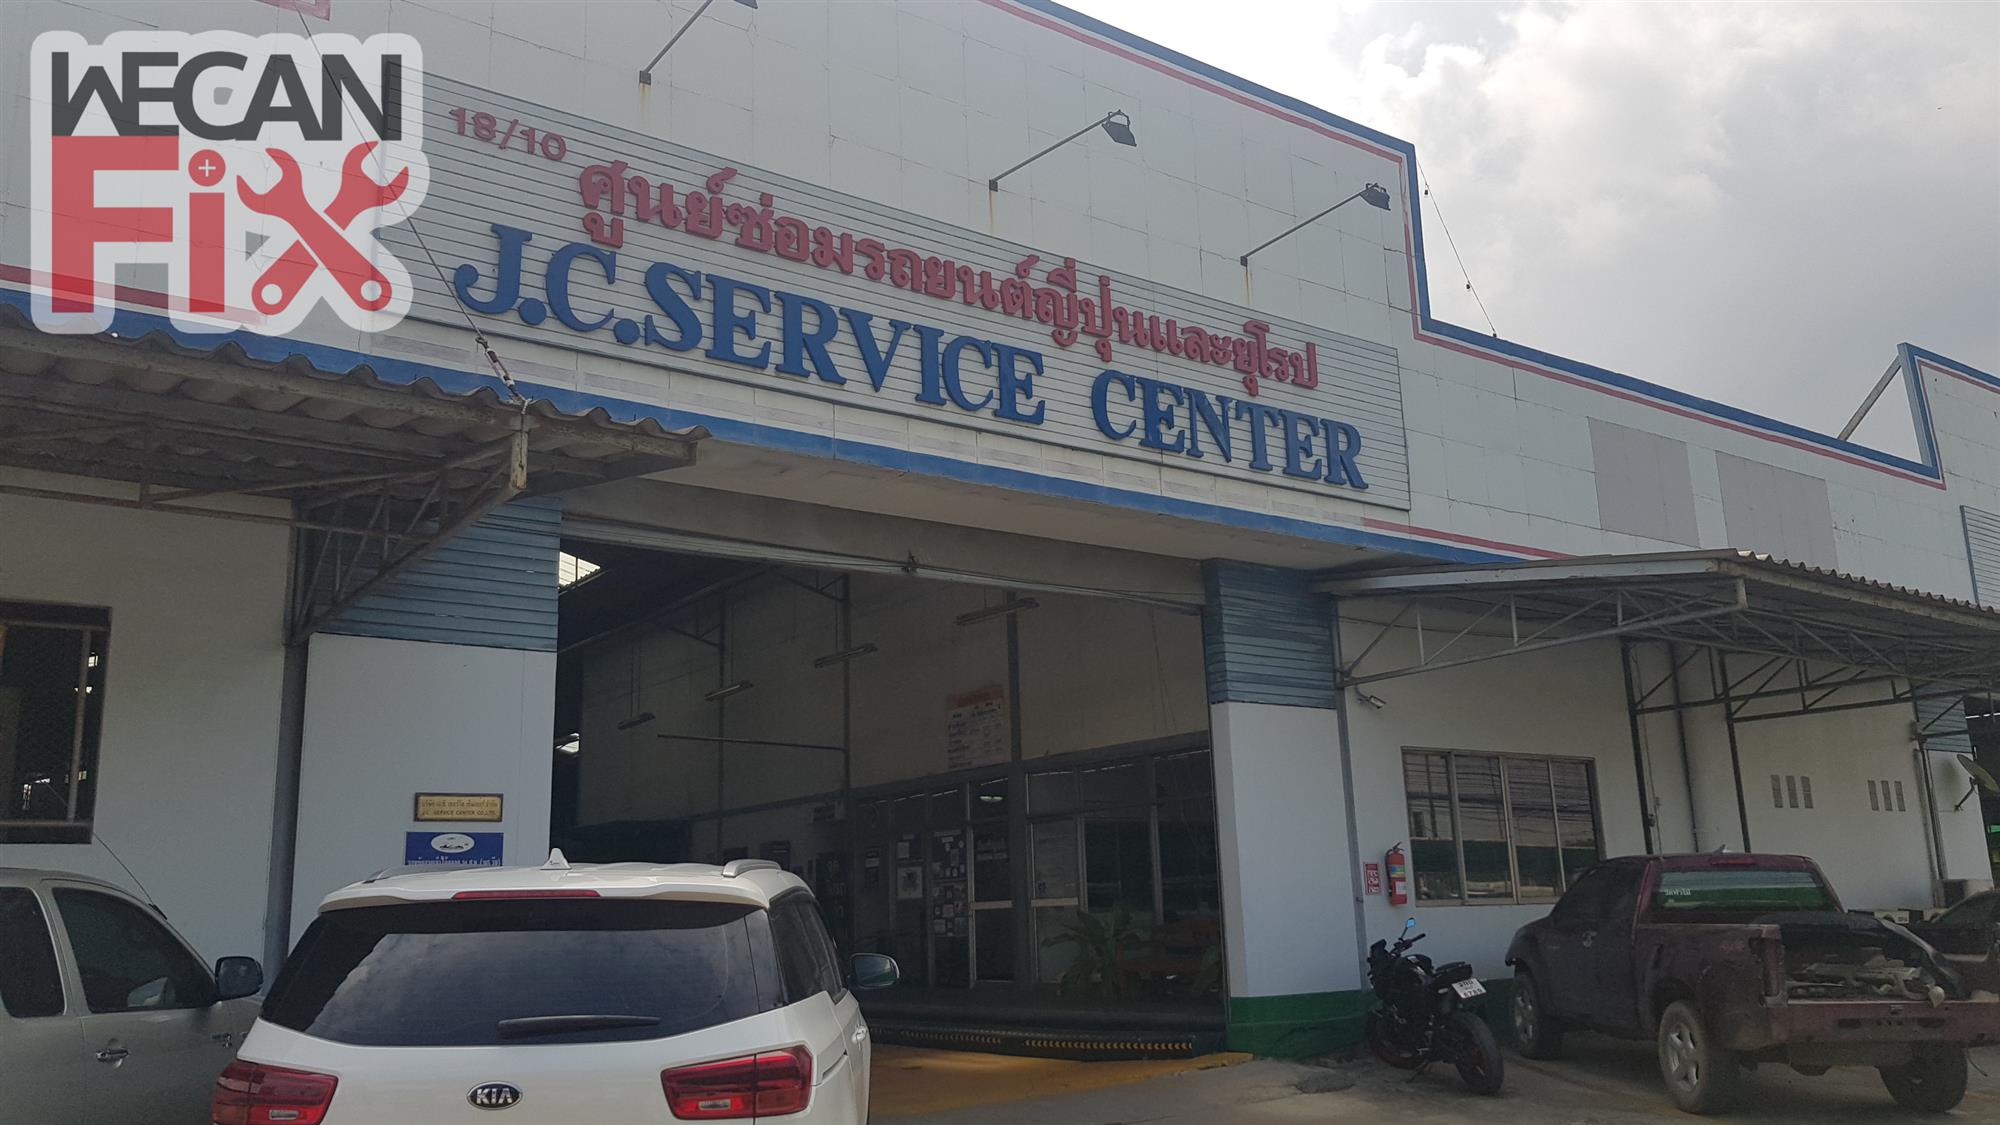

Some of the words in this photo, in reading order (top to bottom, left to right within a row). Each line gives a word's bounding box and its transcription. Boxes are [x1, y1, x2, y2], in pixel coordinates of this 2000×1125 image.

[450, 106, 567, 162] 18/10
[579, 159, 1319, 397] ศูนย์ซ่อมรถยนต์ญี่ปุ่นและยุโรป
[1090, 369, 1370, 490] CENTER
[476, 1087, 513, 1104] KIA
